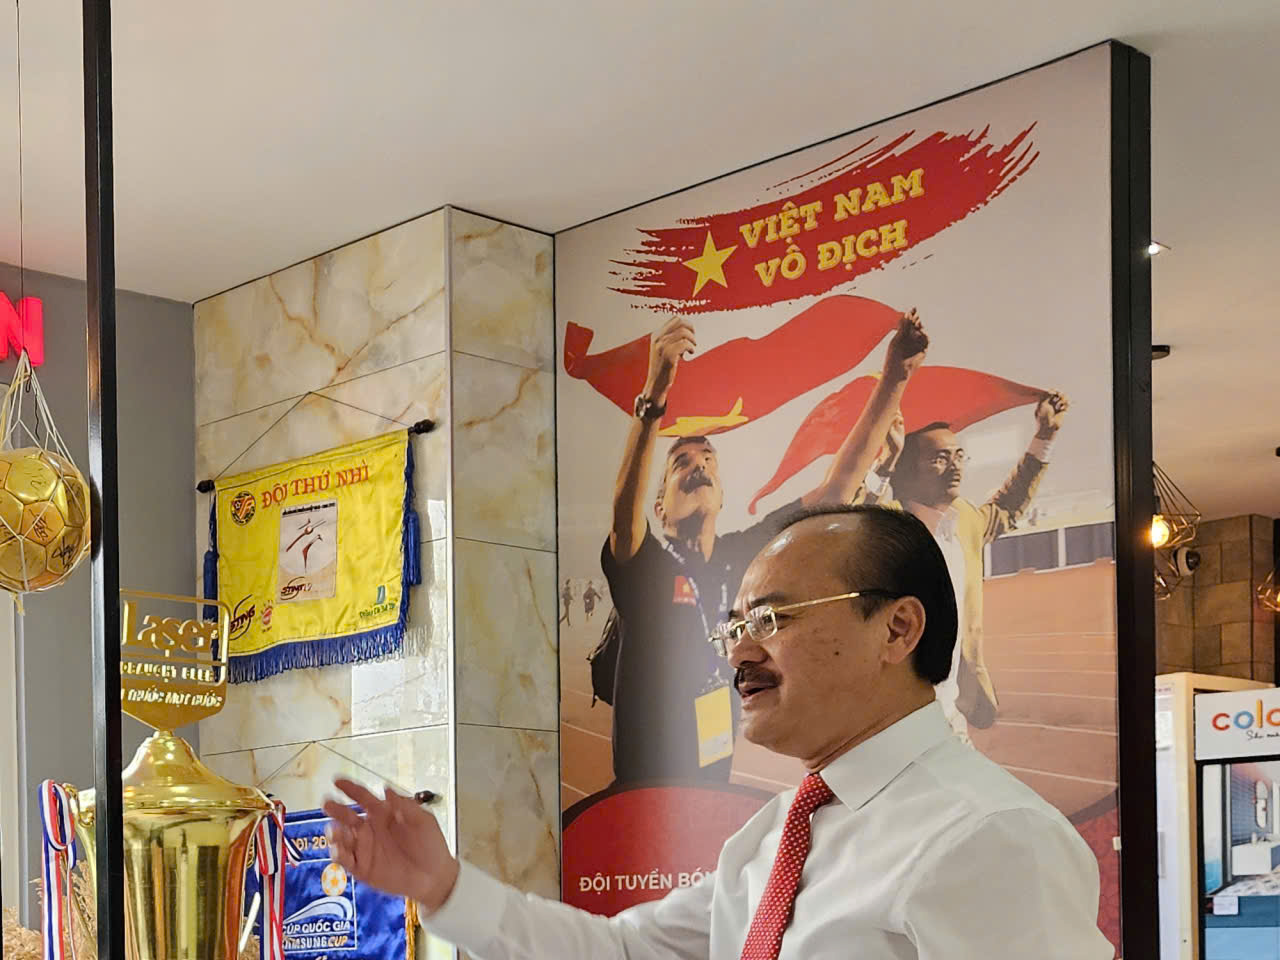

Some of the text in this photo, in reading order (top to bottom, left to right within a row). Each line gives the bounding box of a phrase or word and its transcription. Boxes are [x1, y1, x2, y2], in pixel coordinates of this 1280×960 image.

[739, 168, 925, 249] VIỆT NAM
[754, 220, 908, 288] VÔ ĐỊCH
[261, 483, 287, 509] ĐỘI
[291, 469, 330, 497] THỨ
[335, 459, 369, 488] NHÌ
[579, 867, 712, 895] ĐỘI TUYỂN BÓ
[302, 916, 331, 933] QUỐC
[332, 919, 351, 931] GIA
